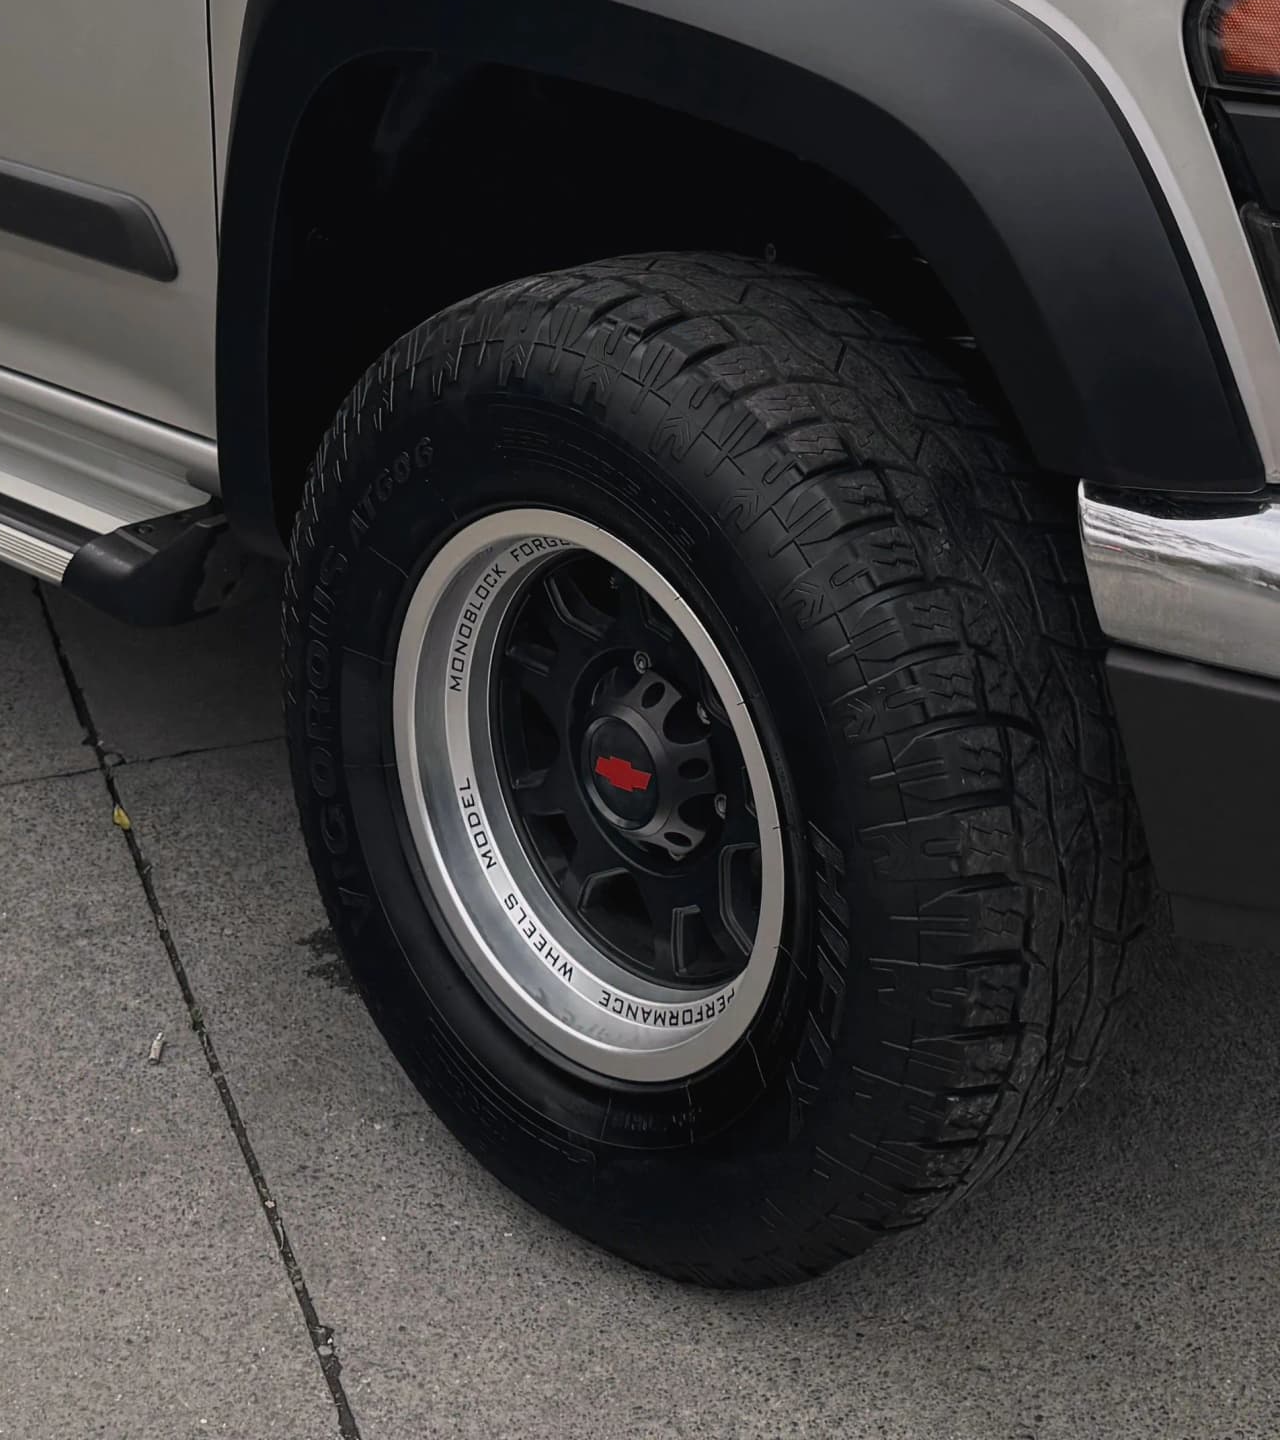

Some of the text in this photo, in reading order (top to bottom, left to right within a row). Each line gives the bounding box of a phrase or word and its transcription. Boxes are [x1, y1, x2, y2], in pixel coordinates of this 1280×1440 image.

[449, 563, 507, 692] MONOBLOCK
[459, 777, 497, 870] MODEL
[504, 892, 574, 983] WHEELS
